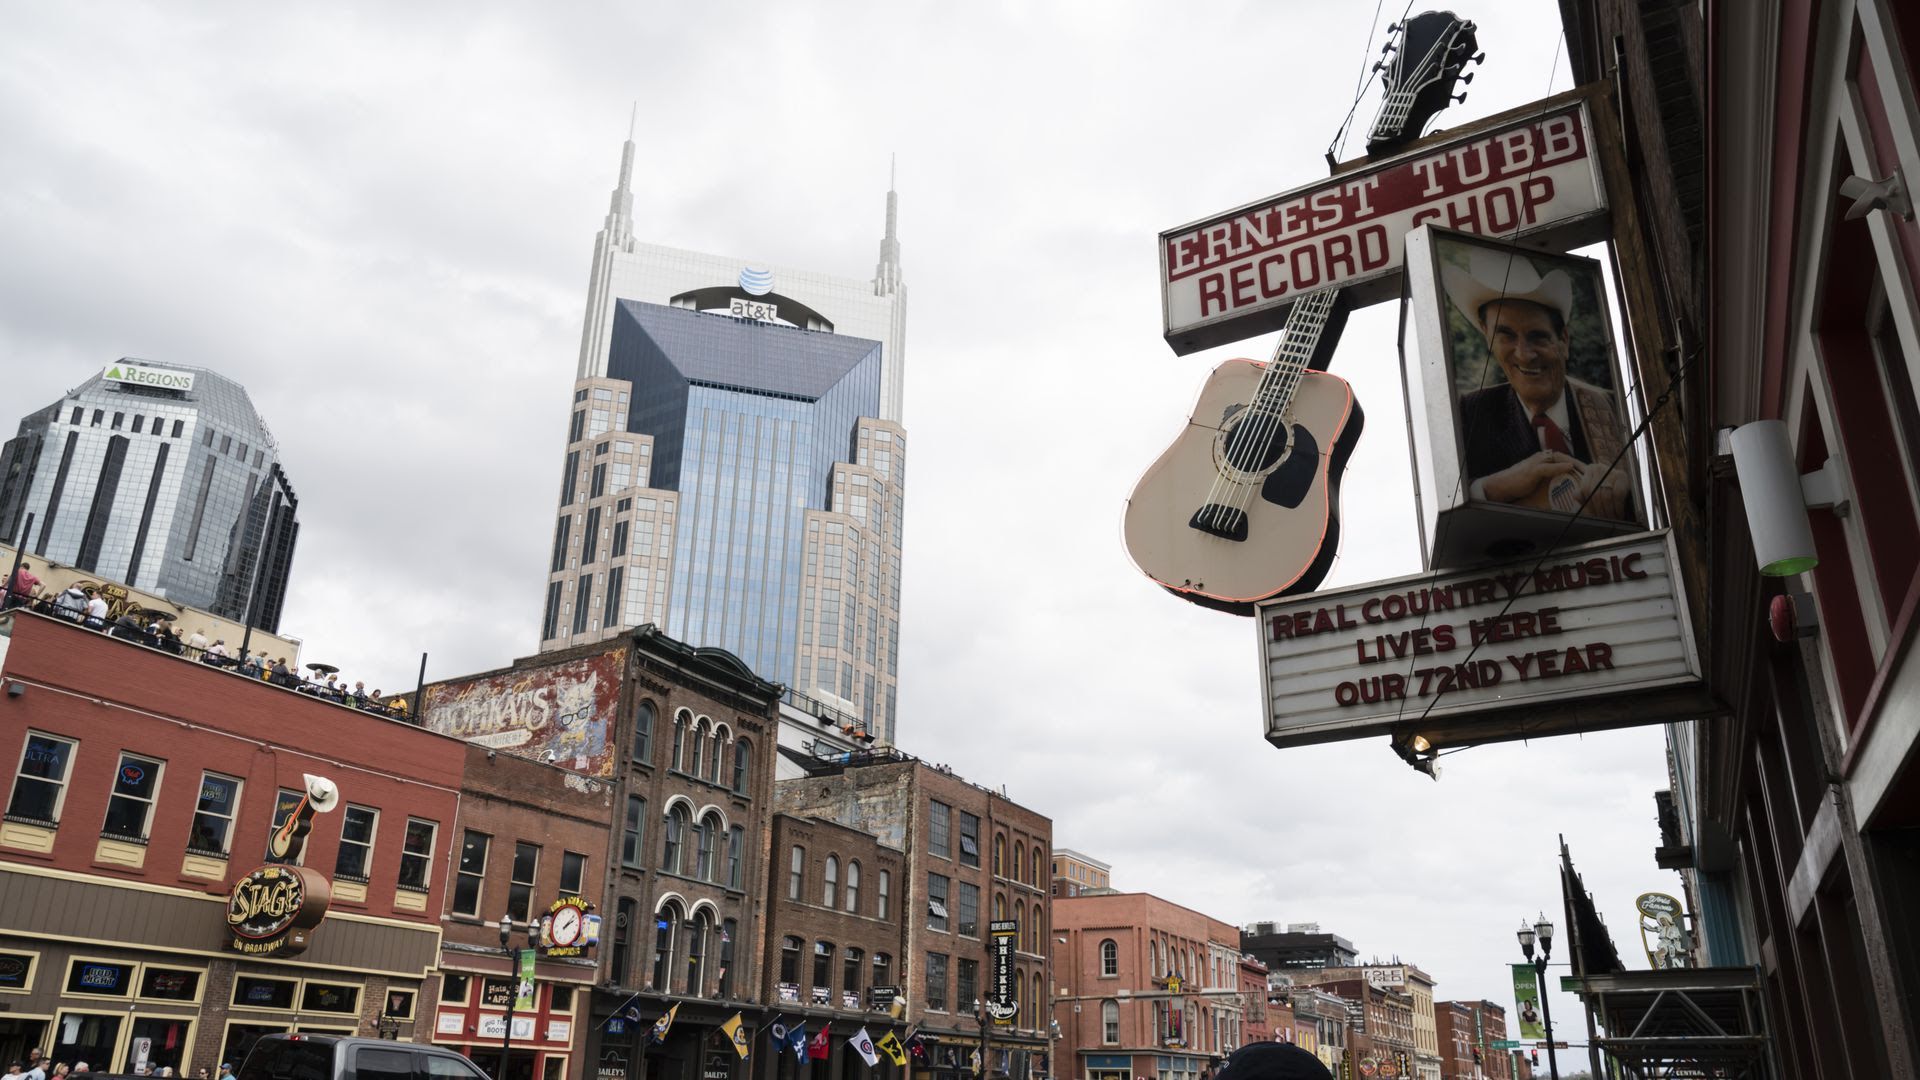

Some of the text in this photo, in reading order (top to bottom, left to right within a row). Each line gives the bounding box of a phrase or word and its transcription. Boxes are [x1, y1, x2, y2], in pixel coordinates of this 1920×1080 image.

[1171, 114, 1579, 275] ERNEST TUBB
[1199, 224, 1390, 317] RECORD
[731, 301, 775, 321] at&t
[124, 367, 190, 388] REGIONS
[1272, 552, 1648, 641] REAL COUNTRY MUSIC
[1357, 607, 1563, 664] LIVES HERE
[1335, 642, 1614, 707] OUR 72ND YEAR
[228, 878, 299, 925] STAGE
[233, 937, 286, 953] ON BROADWAY
[998, 936, 1009, 1004] WHISKEY
[991, 1001, 1013, 1018] Row
[704, 1071, 727, 1079] BAILEY'S
